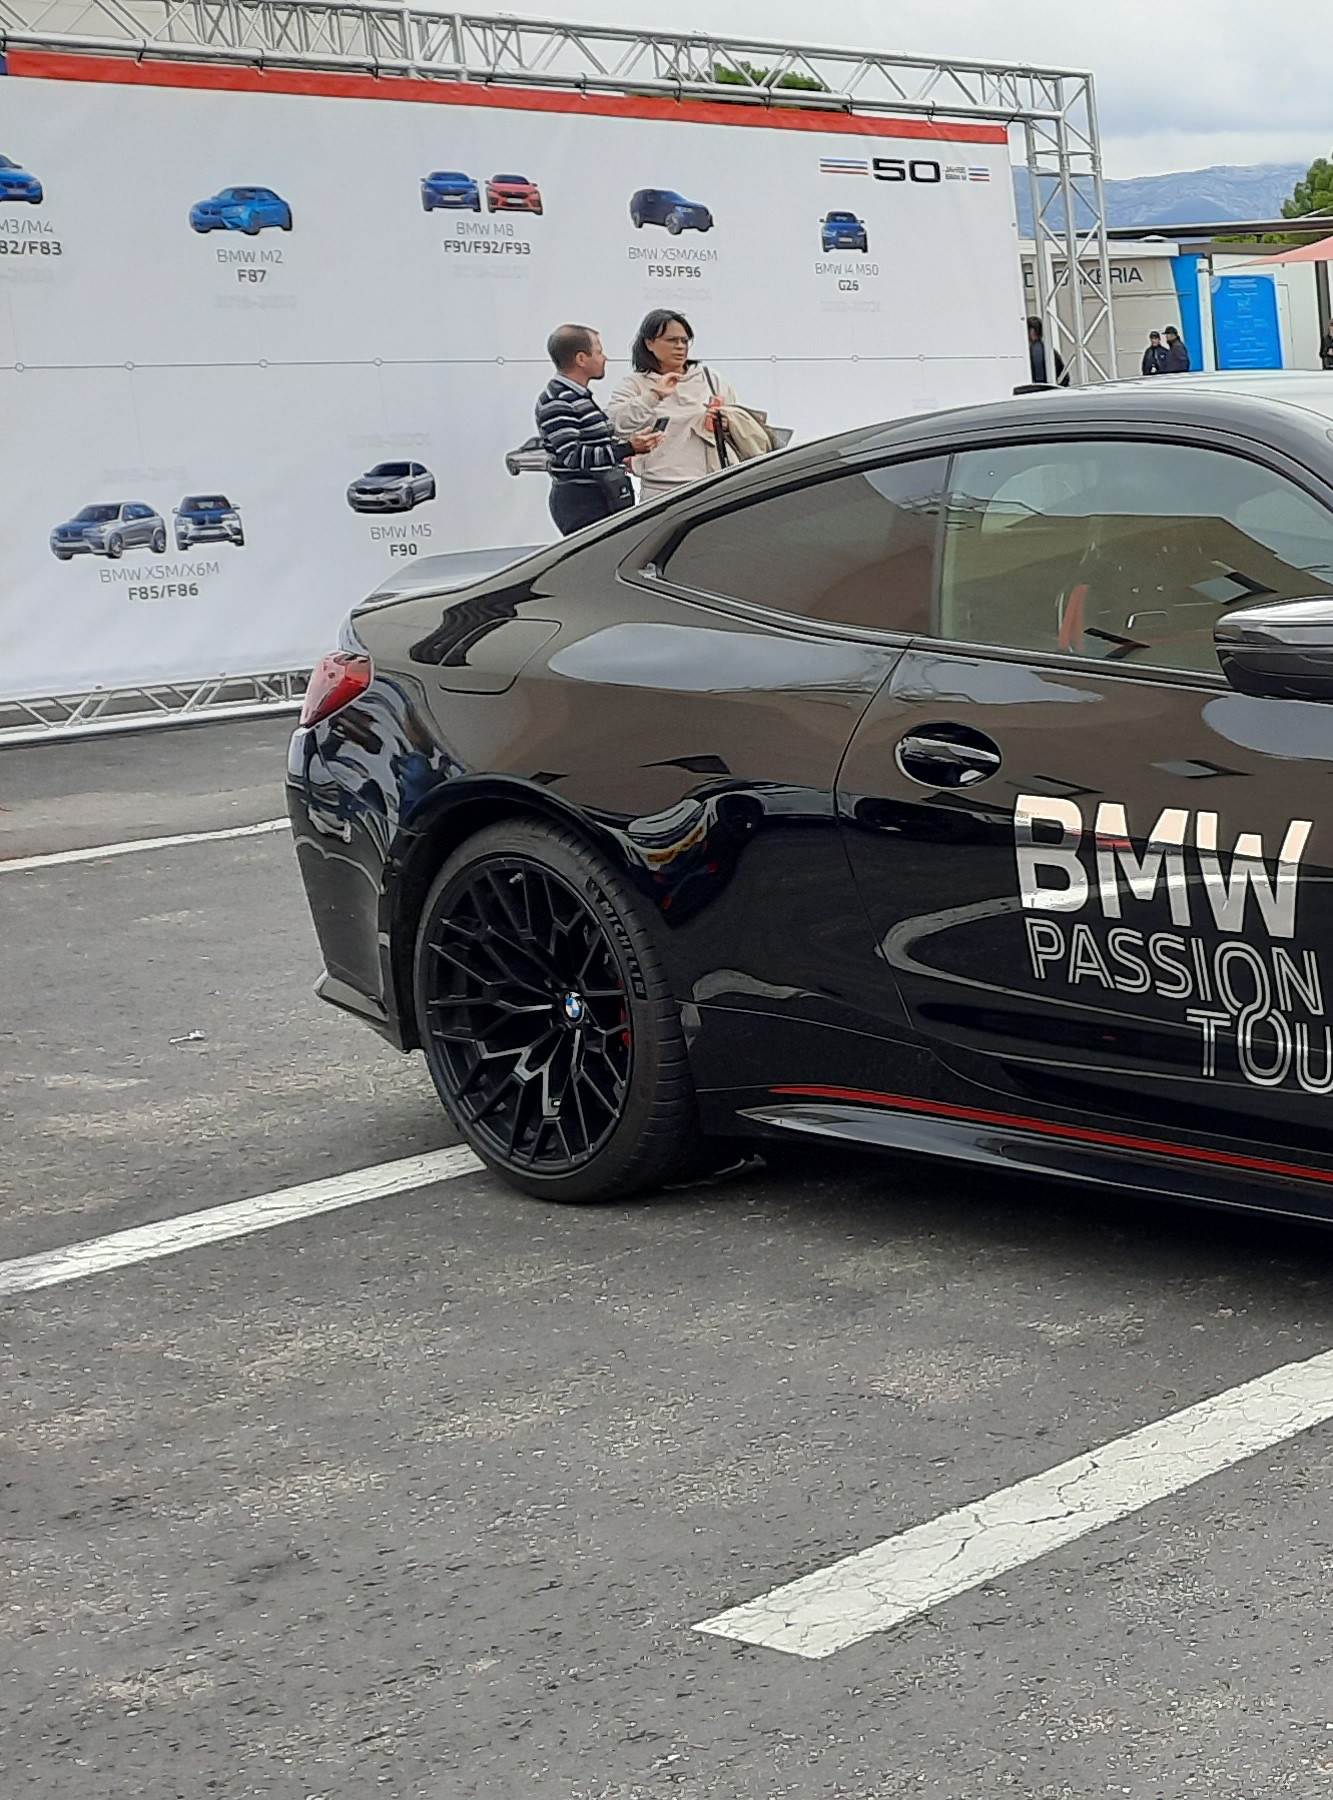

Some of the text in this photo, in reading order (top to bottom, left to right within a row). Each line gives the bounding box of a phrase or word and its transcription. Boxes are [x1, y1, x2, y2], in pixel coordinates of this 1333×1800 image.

[872, 157, 941, 183] 50
[456, 221, 515, 236] BMW M8
[443, 240, 531, 255] F91/F92/F93
[628, 246, 718, 261] BMW X5M/X6M
[216, 248, 284, 264] BMW M2
[237, 268, 267, 283] F87
[647, 264, 702, 278] F95/F96
[815, 262, 842, 275] BMW
[856, 264, 879, 276] M50
[370, 523, 432, 540] BMW M5
[389, 543, 418, 557] F90
[100, 562, 220, 583] BMW X5M/X6M
[128, 583, 199, 601] F85/F86
[1014, 794, 1314, 939] BMW
[1024, 917, 1325, 1016] PASSION
